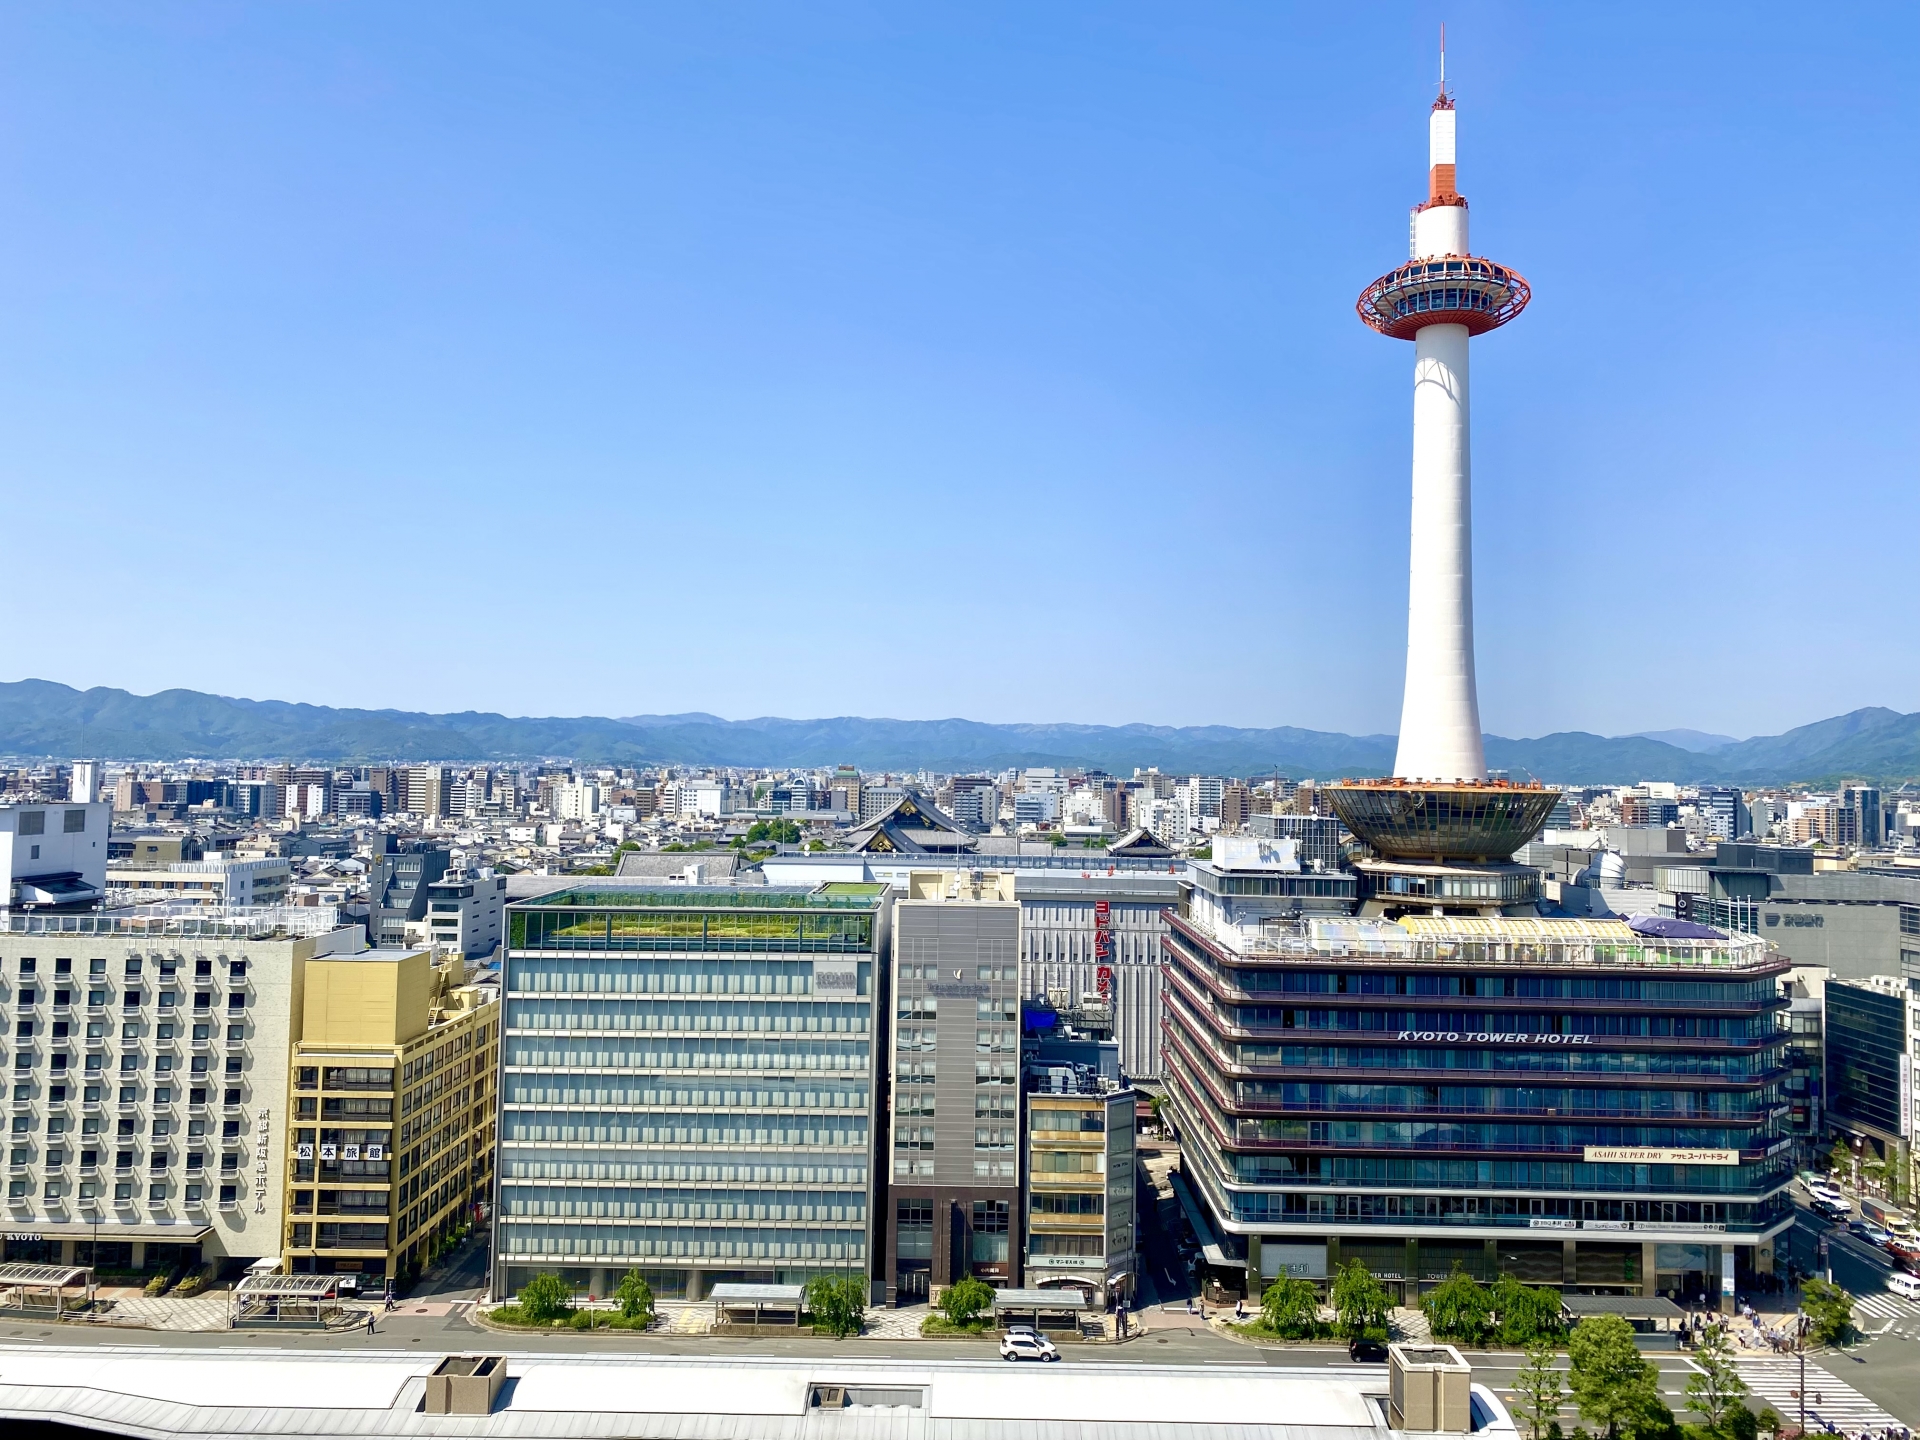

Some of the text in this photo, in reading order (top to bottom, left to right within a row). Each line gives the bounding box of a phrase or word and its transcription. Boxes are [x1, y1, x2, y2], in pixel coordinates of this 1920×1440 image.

[1094, 900, 1110, 957] ヨドバシ
[1398, 1031, 1594, 1044] KYOTO TOWER HOTEL
[299, 1146, 381, 1159] 松本旅館
[254, 1108, 270, 1213] 京都新阪急ホテル
[6, 1233, 42, 1241] KYOTO
